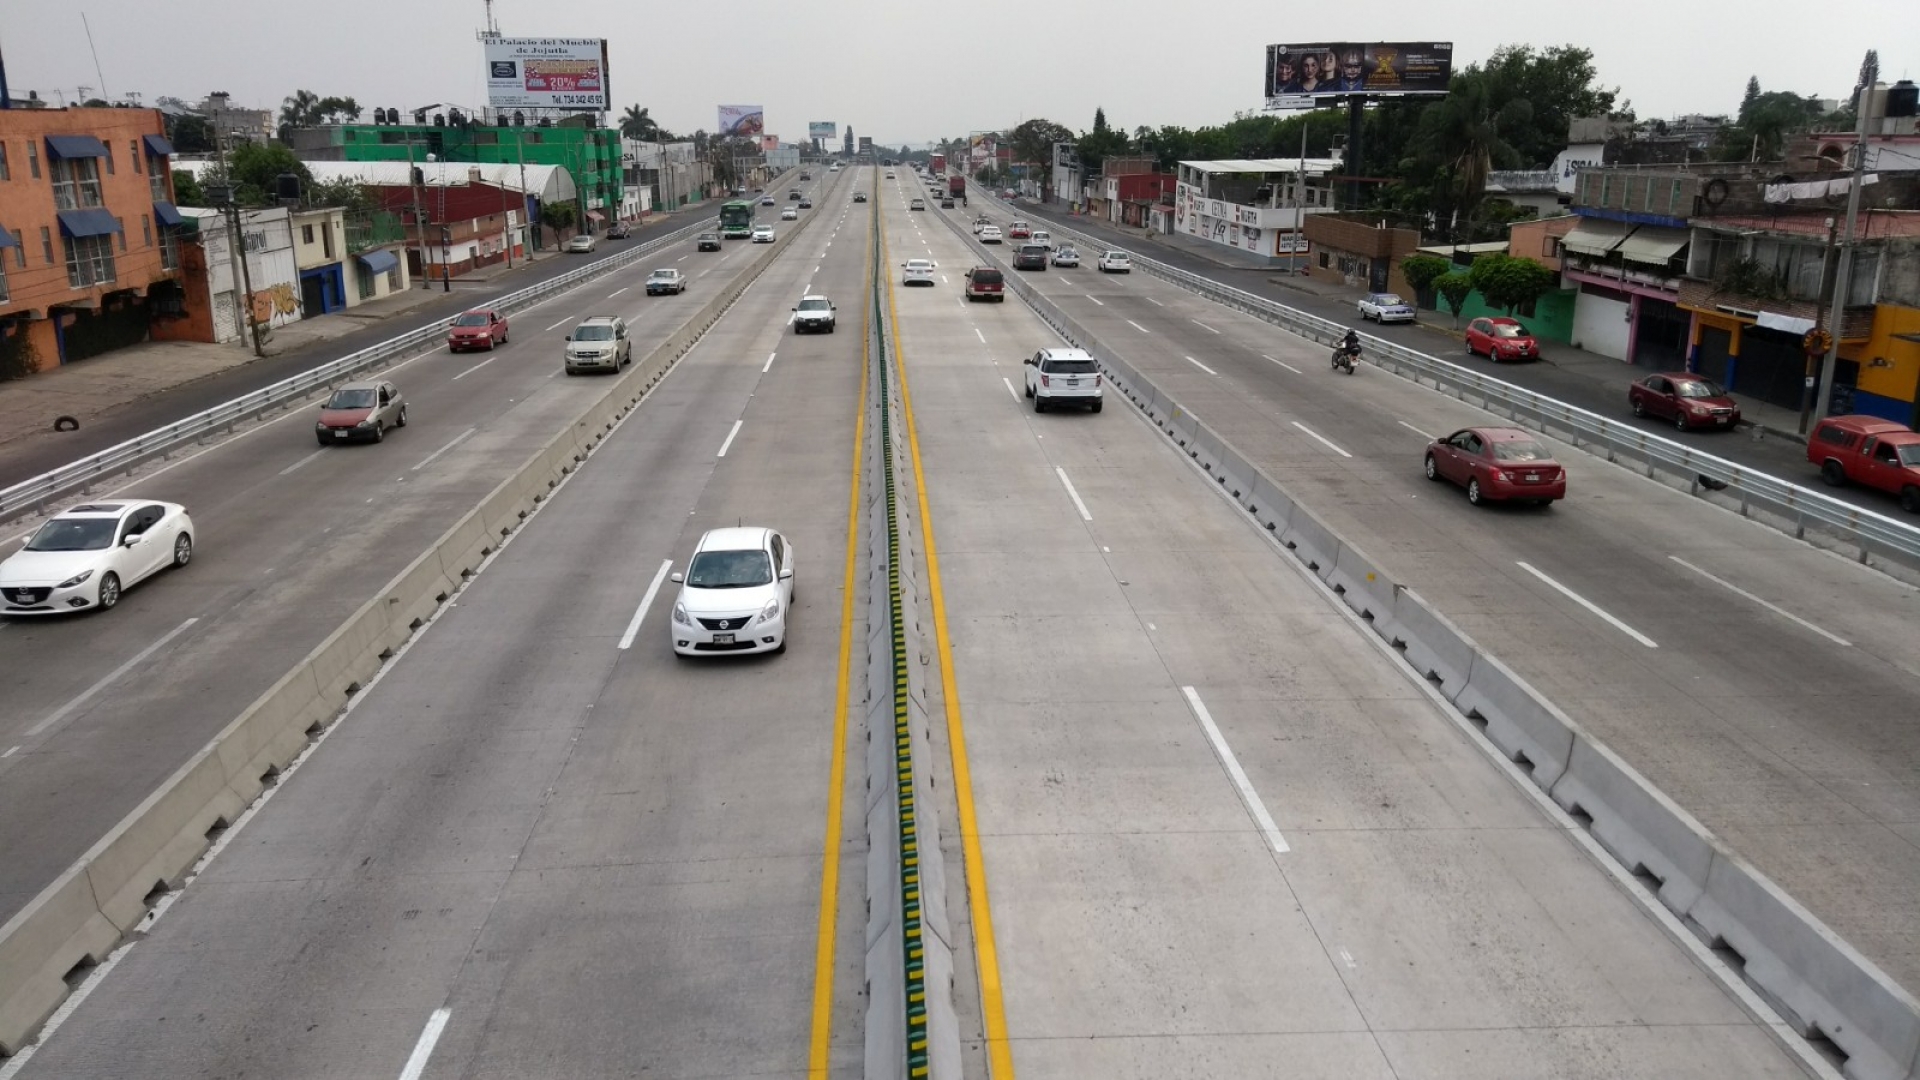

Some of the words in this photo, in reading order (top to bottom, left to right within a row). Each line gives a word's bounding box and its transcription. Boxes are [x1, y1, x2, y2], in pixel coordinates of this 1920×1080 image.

[560, 39, 599, 47] Mueble
[531, 47, 568, 55] Jojutla
[550, 77, 576, 87] 20%
[552, 95, 563, 104] Tel.
